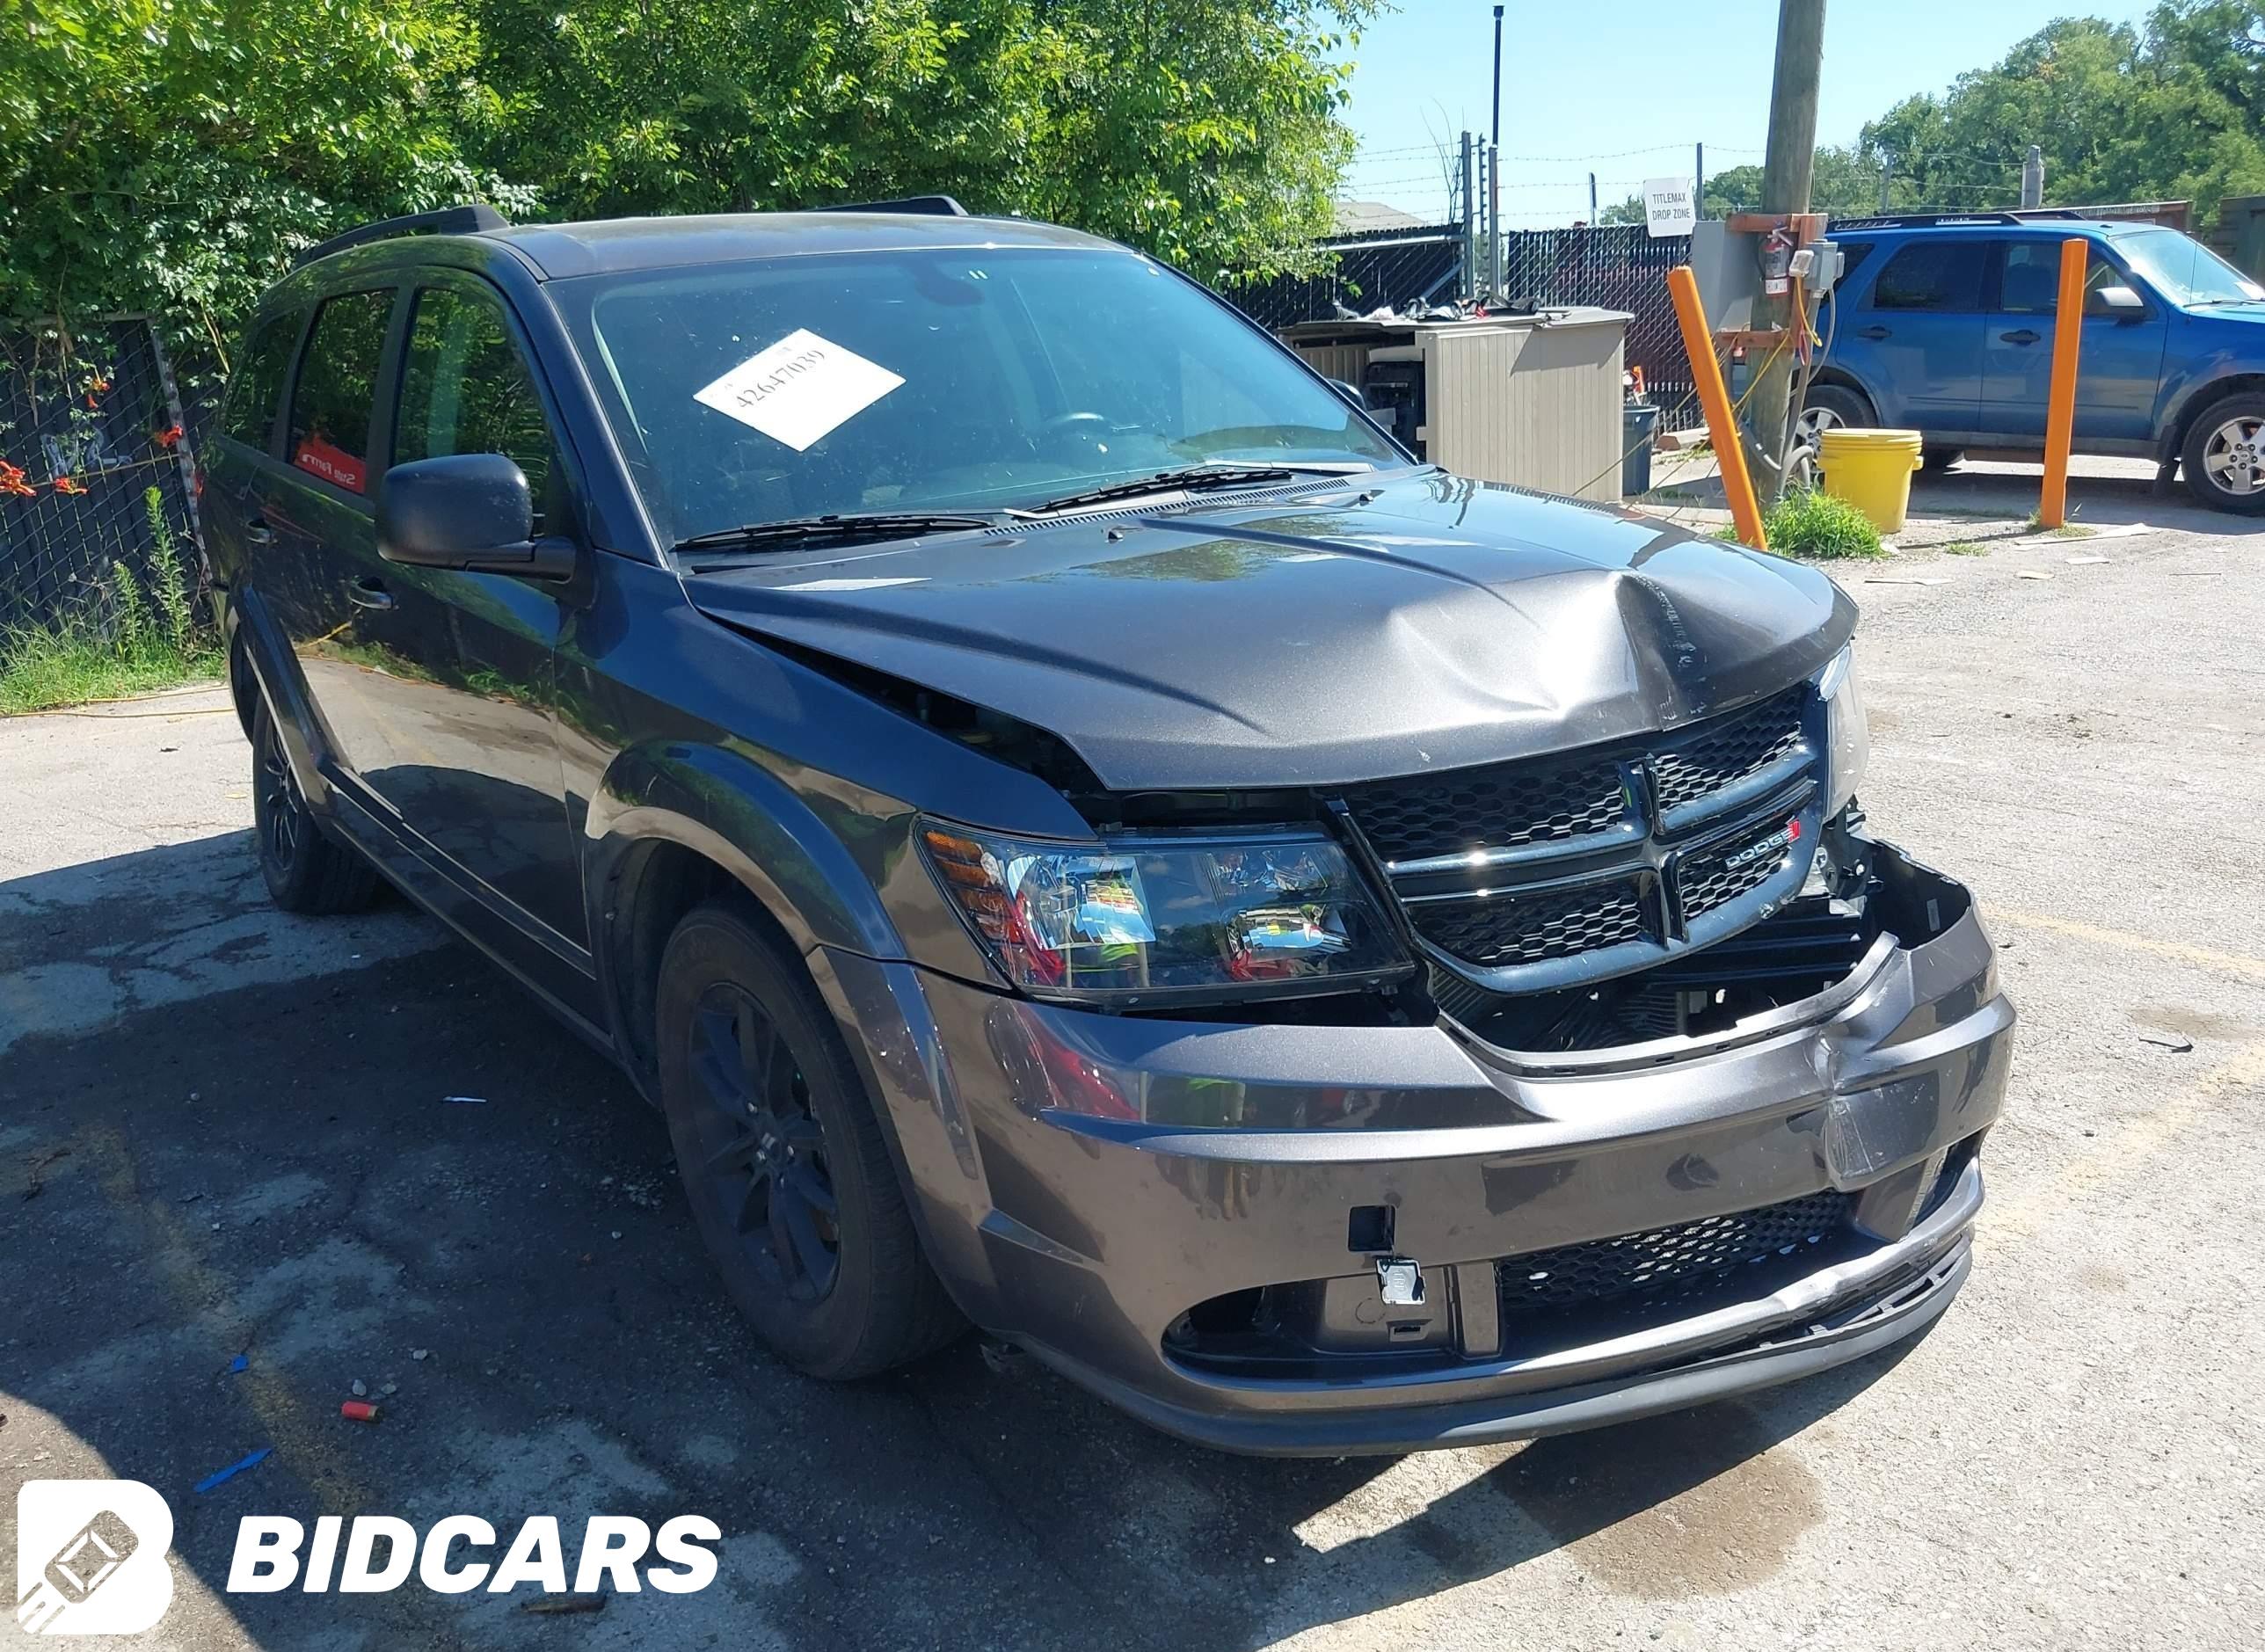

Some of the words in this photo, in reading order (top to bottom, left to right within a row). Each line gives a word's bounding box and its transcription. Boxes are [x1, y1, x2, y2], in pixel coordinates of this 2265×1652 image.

[1652, 193, 1686, 205] TITLEMAX
[1652, 209, 1671, 221] DROP
[1673, 208, 1691, 219] ZONE
[736, 349, 826, 408] 42647039
[1724, 827, 1795, 870] DODGE
